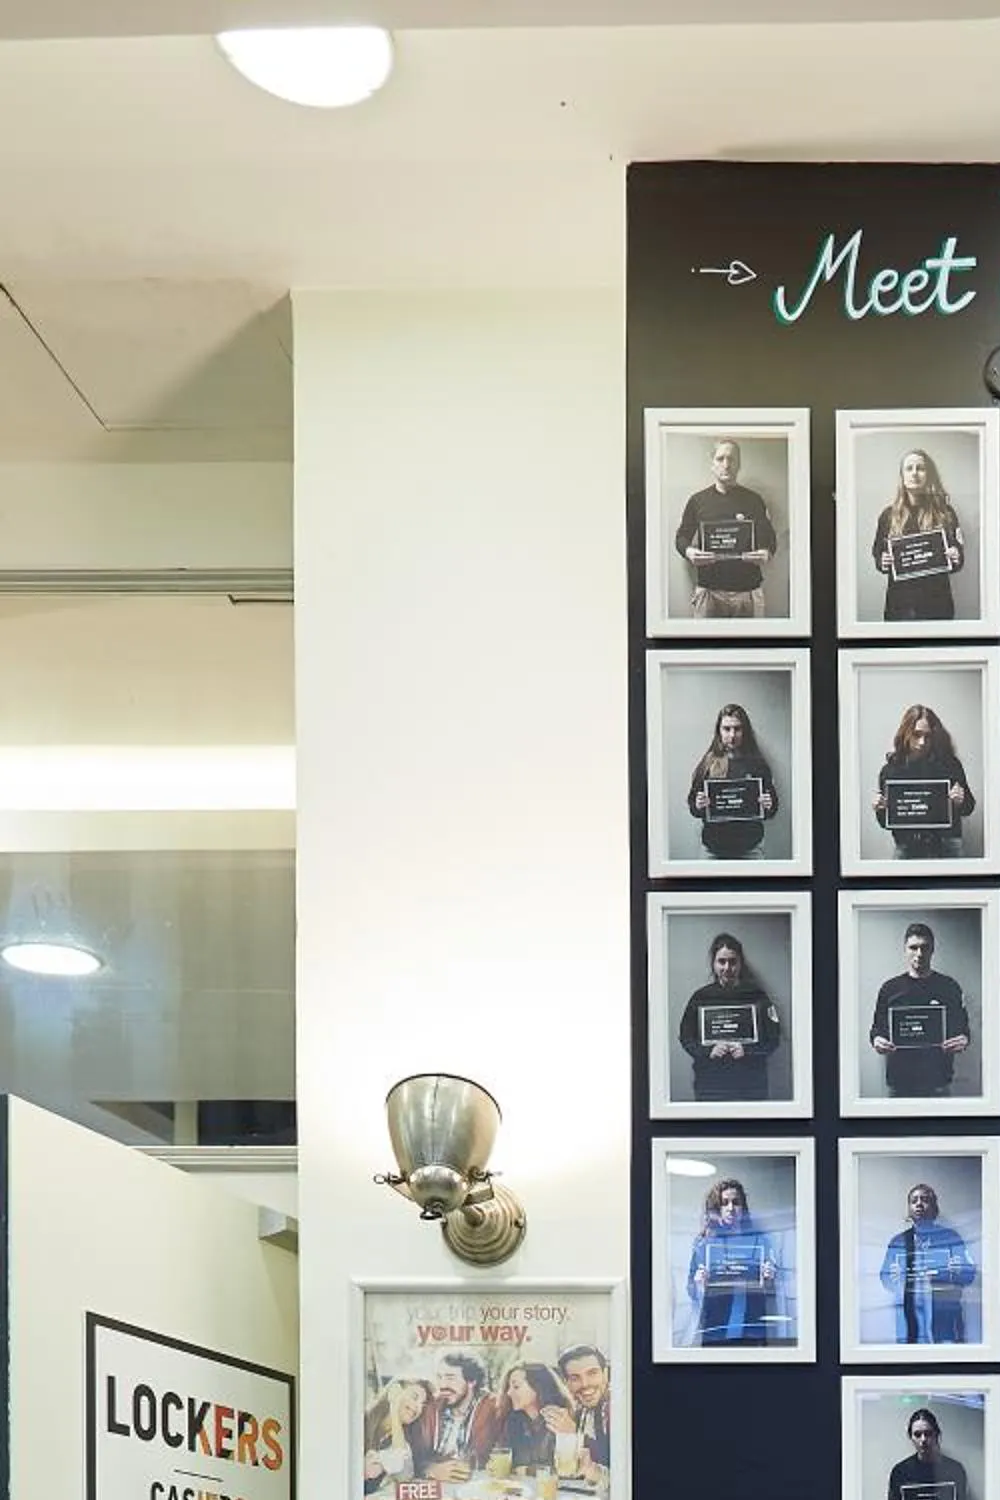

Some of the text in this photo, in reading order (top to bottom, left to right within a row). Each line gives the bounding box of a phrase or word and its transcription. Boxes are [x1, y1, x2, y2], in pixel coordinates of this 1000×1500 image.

[773, 229, 977, 323] Meet
[480, 1306, 520, 1324] your
[523, 1304, 571, 1325] story.
[417, 1324, 532, 1346] your way.
[107, 1375, 284, 1471] LOCKERS
[399, 1483, 439, 1500] FREE
